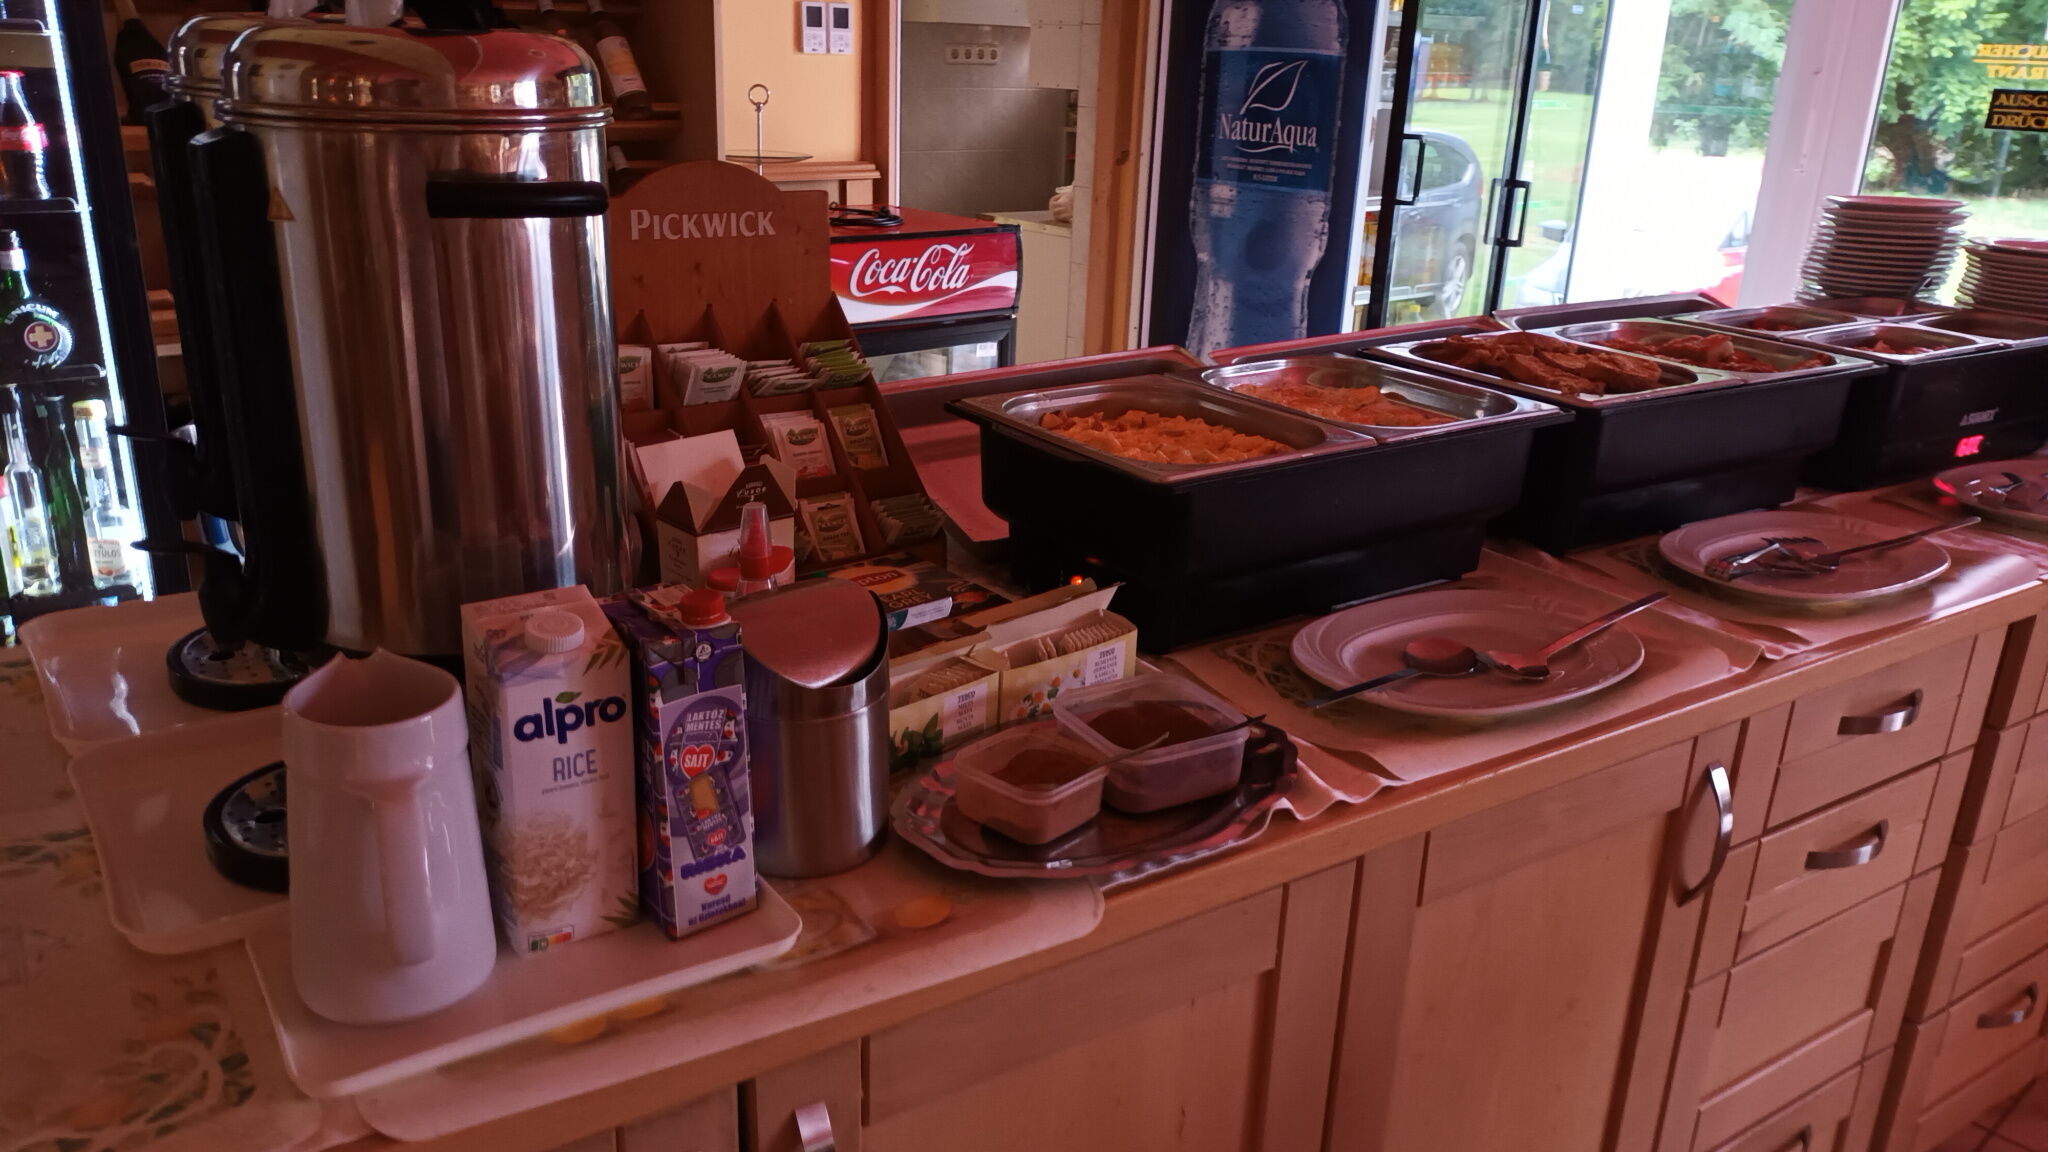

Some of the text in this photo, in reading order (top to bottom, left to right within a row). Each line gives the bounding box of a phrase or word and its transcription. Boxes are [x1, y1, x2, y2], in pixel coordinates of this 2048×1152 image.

[1218, 113, 1318, 153] NaturAqua
[1991, 112, 2048, 129] DRÜC
[630, 209, 776, 241] PICKWICK
[850, 243, 975, 297] Coca-Cola
[4, 303, 60, 325] UNICUM
[513, 695, 627, 745] alpro
[686, 719, 722, 732] MENTES
[552, 749, 599, 783] RICE
[683, 753, 710, 768] SAJT
